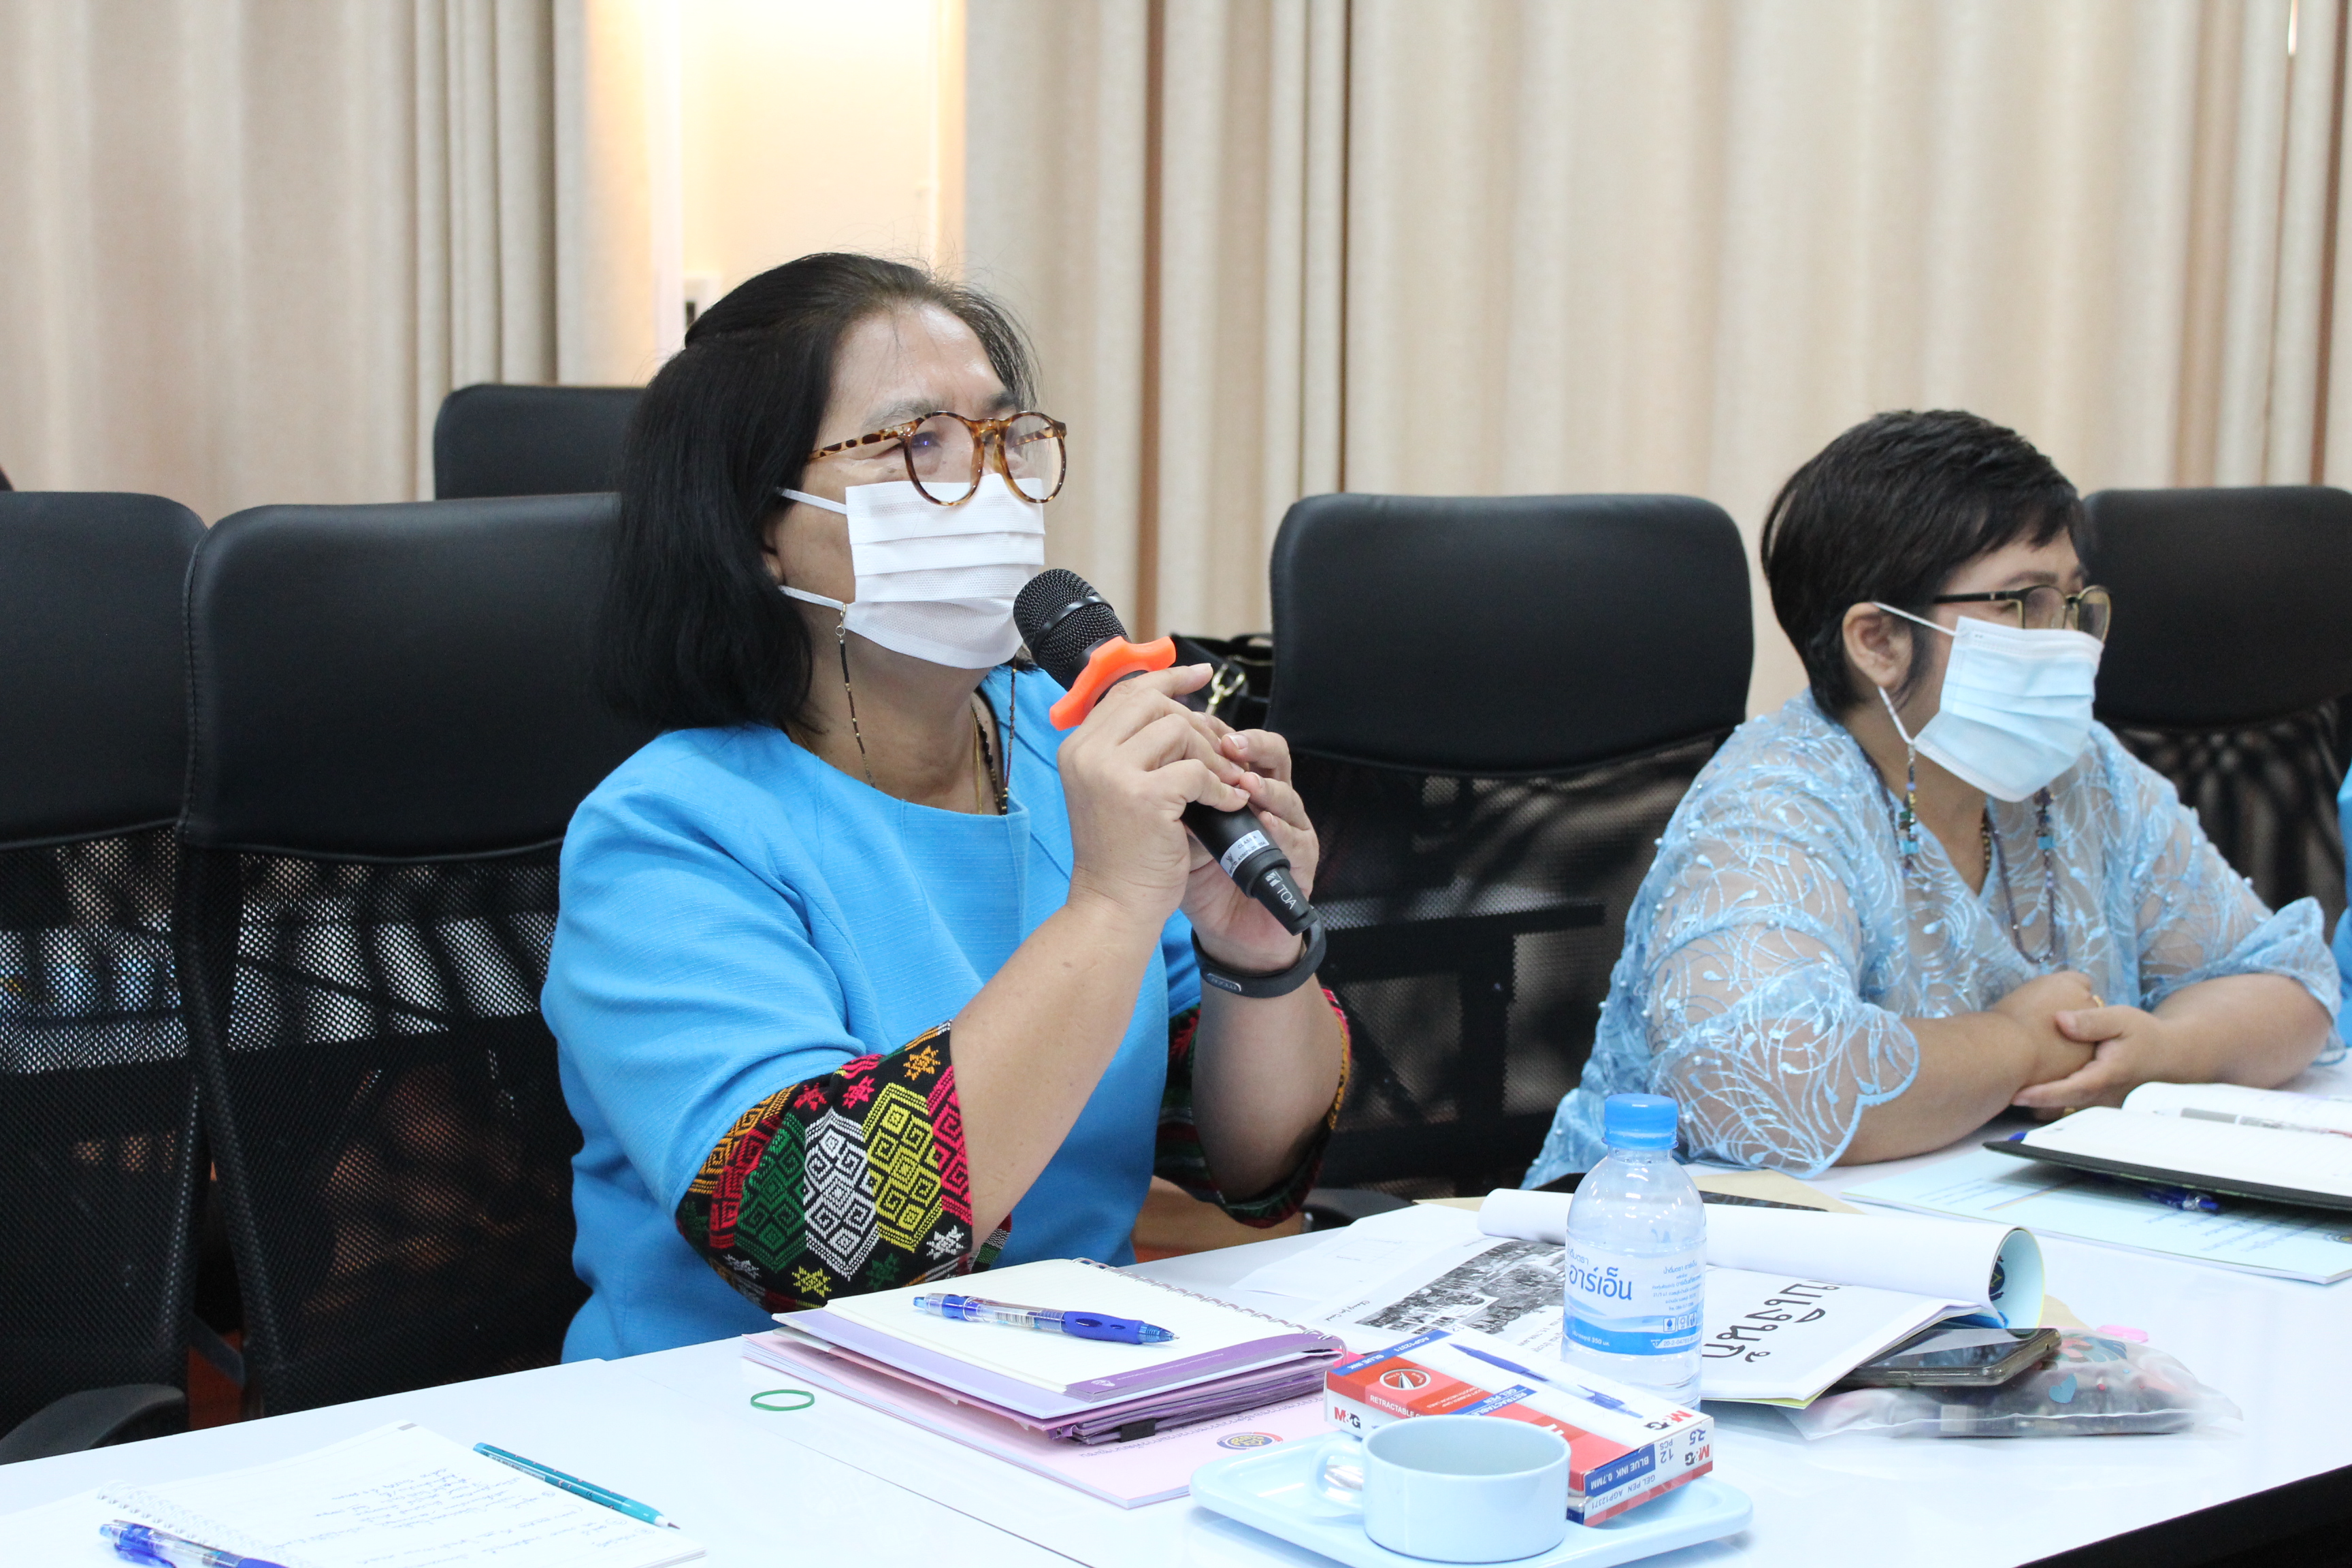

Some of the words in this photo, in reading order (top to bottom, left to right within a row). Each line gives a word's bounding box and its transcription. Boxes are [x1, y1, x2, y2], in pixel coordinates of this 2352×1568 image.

[1238, 838, 1252, 849] CLASS
[1277, 884, 1296, 909] TOA
[1569, 1264, 1632, 1301] อาร์เอ็น
[1591, 1337, 1602, 1345] 350
[1347, 1361, 1363, 1369] INK
[1364, 1354, 1384, 1364] BLUE
[1499, 1388, 1517, 1396] GEL
[1482, 1395, 1501, 1403] PEN
[1370, 1395, 1414, 1418] RETRACTABLE
[1334, 1406, 1361, 1429] M&G
[1644, 1410, 1694, 1429] M&G
[1659, 1439, 1673, 1450] PCS
[1661, 1449, 1674, 1463] 12
[1685, 1444, 1710, 1466] M&G
[1631, 1455, 1650, 1471] BLUE
[1616, 1466, 1631, 1478] INK
[1590, 1473, 1613, 1490] 0.7MM
[1644, 1475, 1656, 1485] GEL
[1628, 1482, 1641, 1493] PEN
[1592, 1489, 1623, 1509] AGP12371
